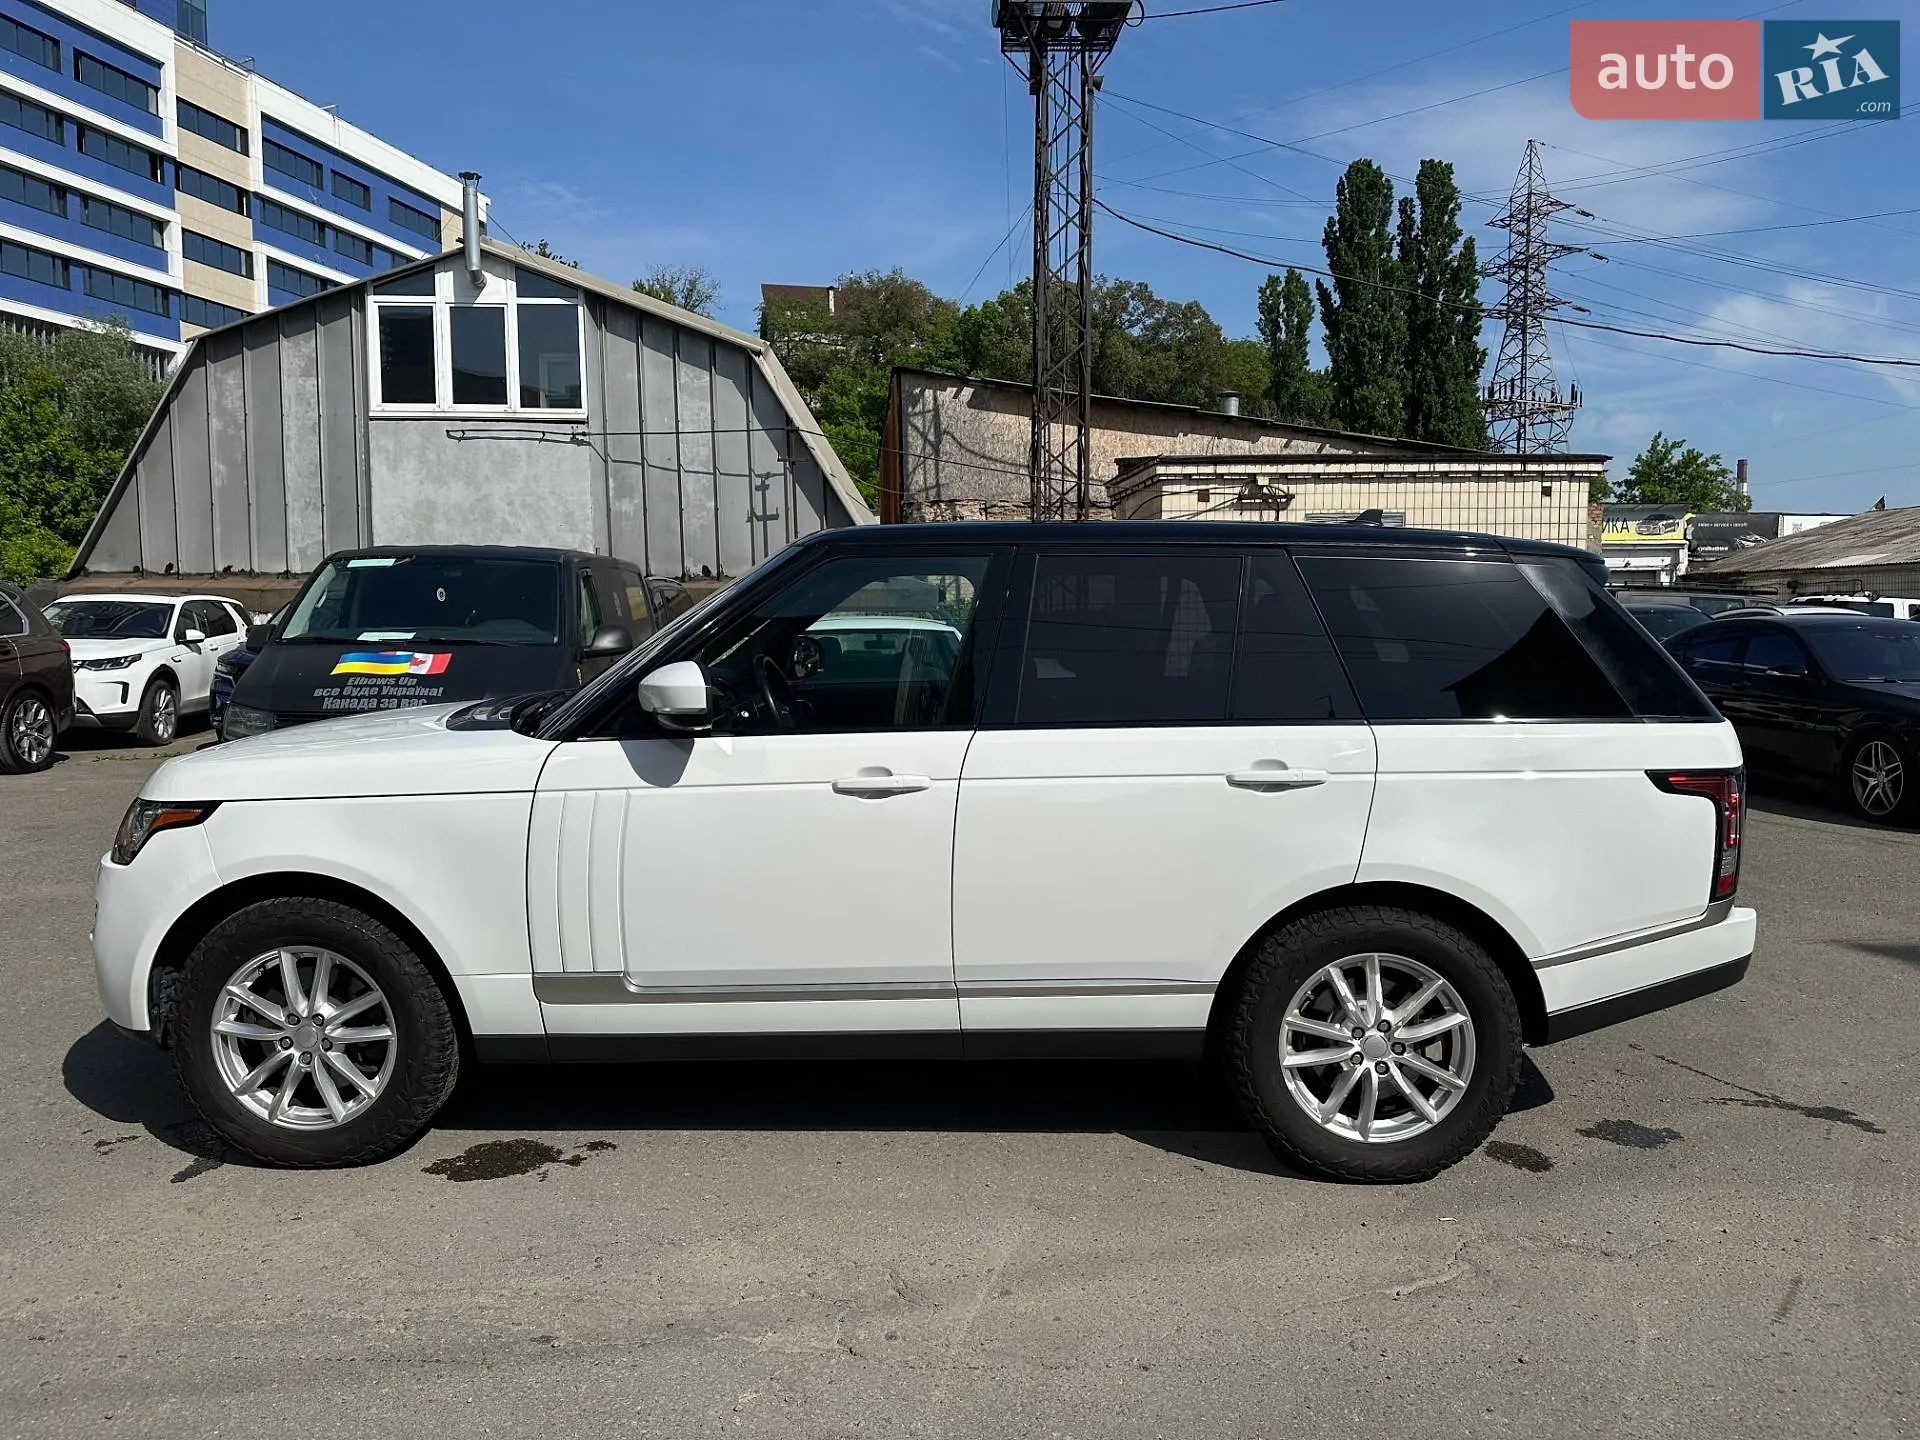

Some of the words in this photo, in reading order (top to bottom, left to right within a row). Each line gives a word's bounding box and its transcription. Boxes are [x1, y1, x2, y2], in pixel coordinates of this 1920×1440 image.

[347, 677, 396, 685] Elbows
[398, 677, 418, 686] Up
[312, 687, 341, 697] все
[342, 686, 379, 697] буде
[380, 686, 444, 697] Україна!
[323, 697, 378, 710] Канада
[379, 698, 398, 709] за
